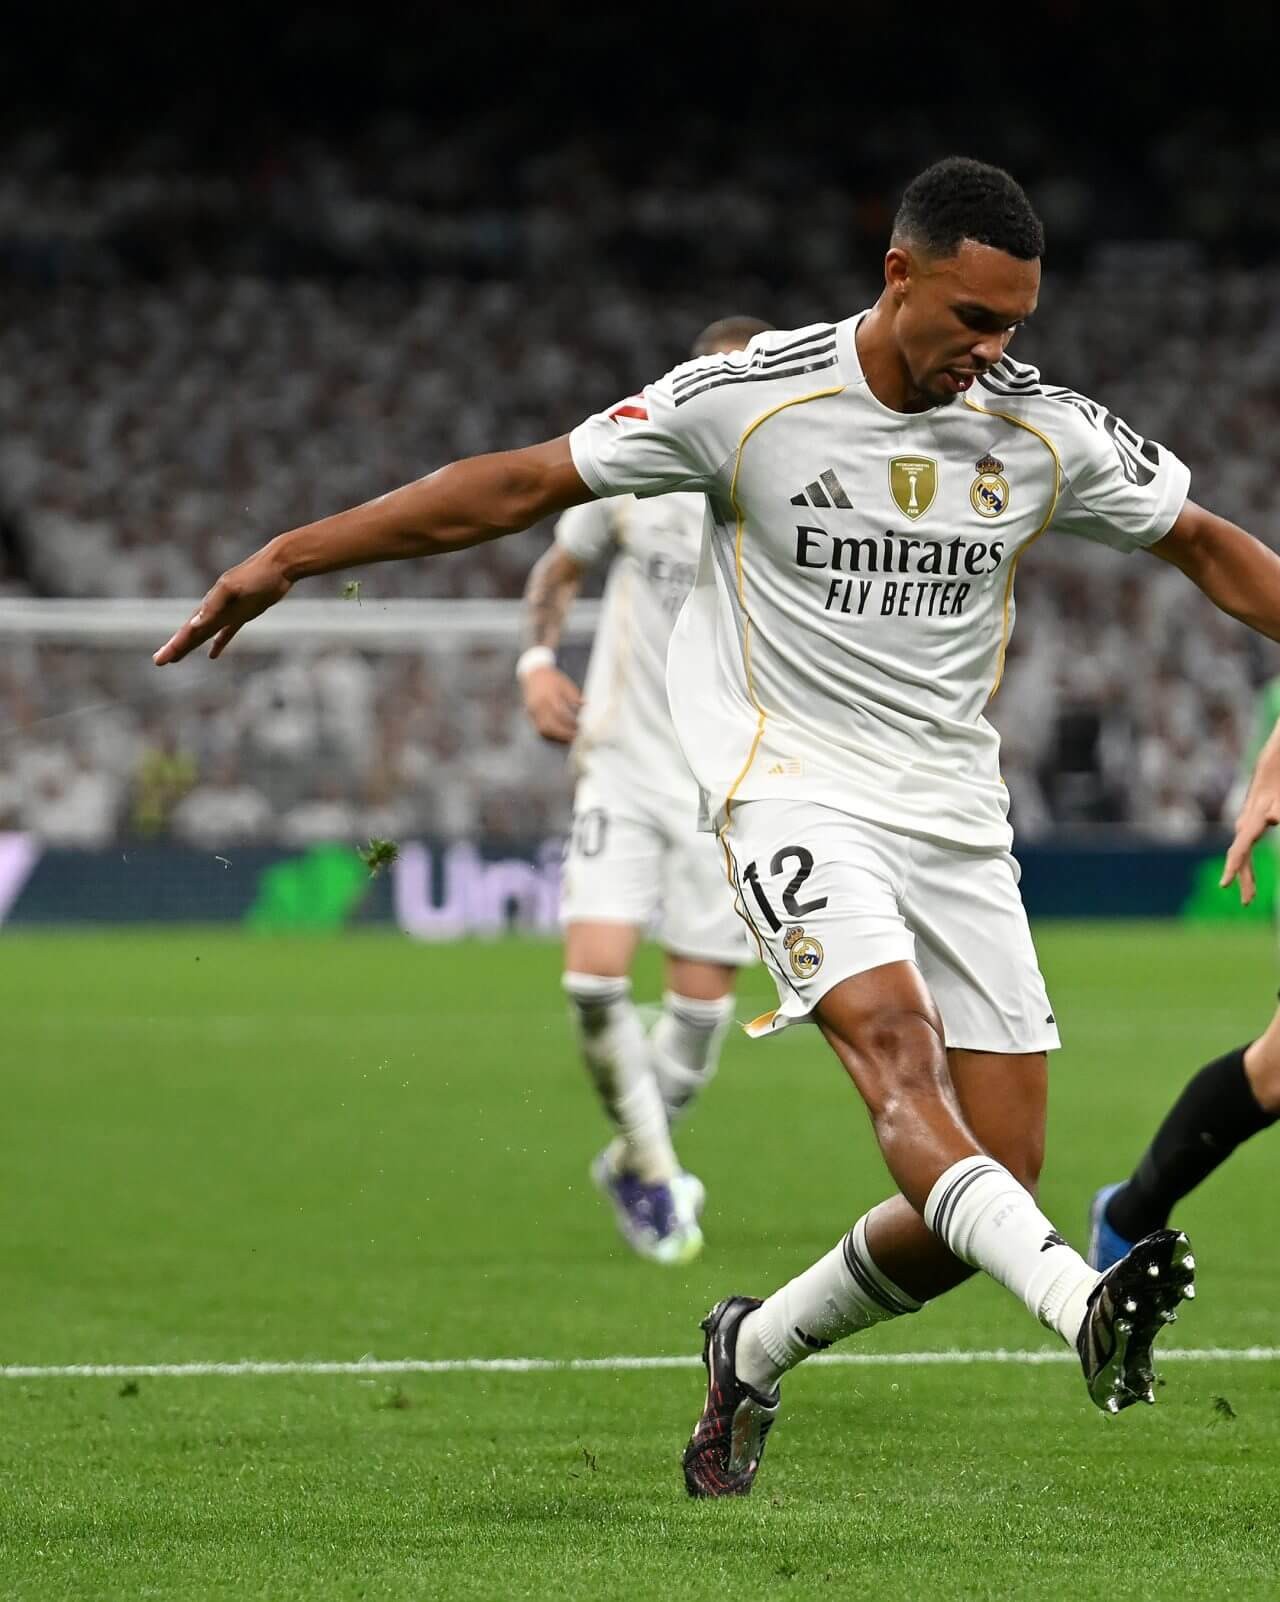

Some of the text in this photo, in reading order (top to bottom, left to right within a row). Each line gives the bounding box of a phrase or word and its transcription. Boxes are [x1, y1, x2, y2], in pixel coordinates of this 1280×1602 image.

[796, 525, 1004, 576] Emirates
[825, 578, 971, 617] FLY BETTER
[743, 845, 828, 934] 12
